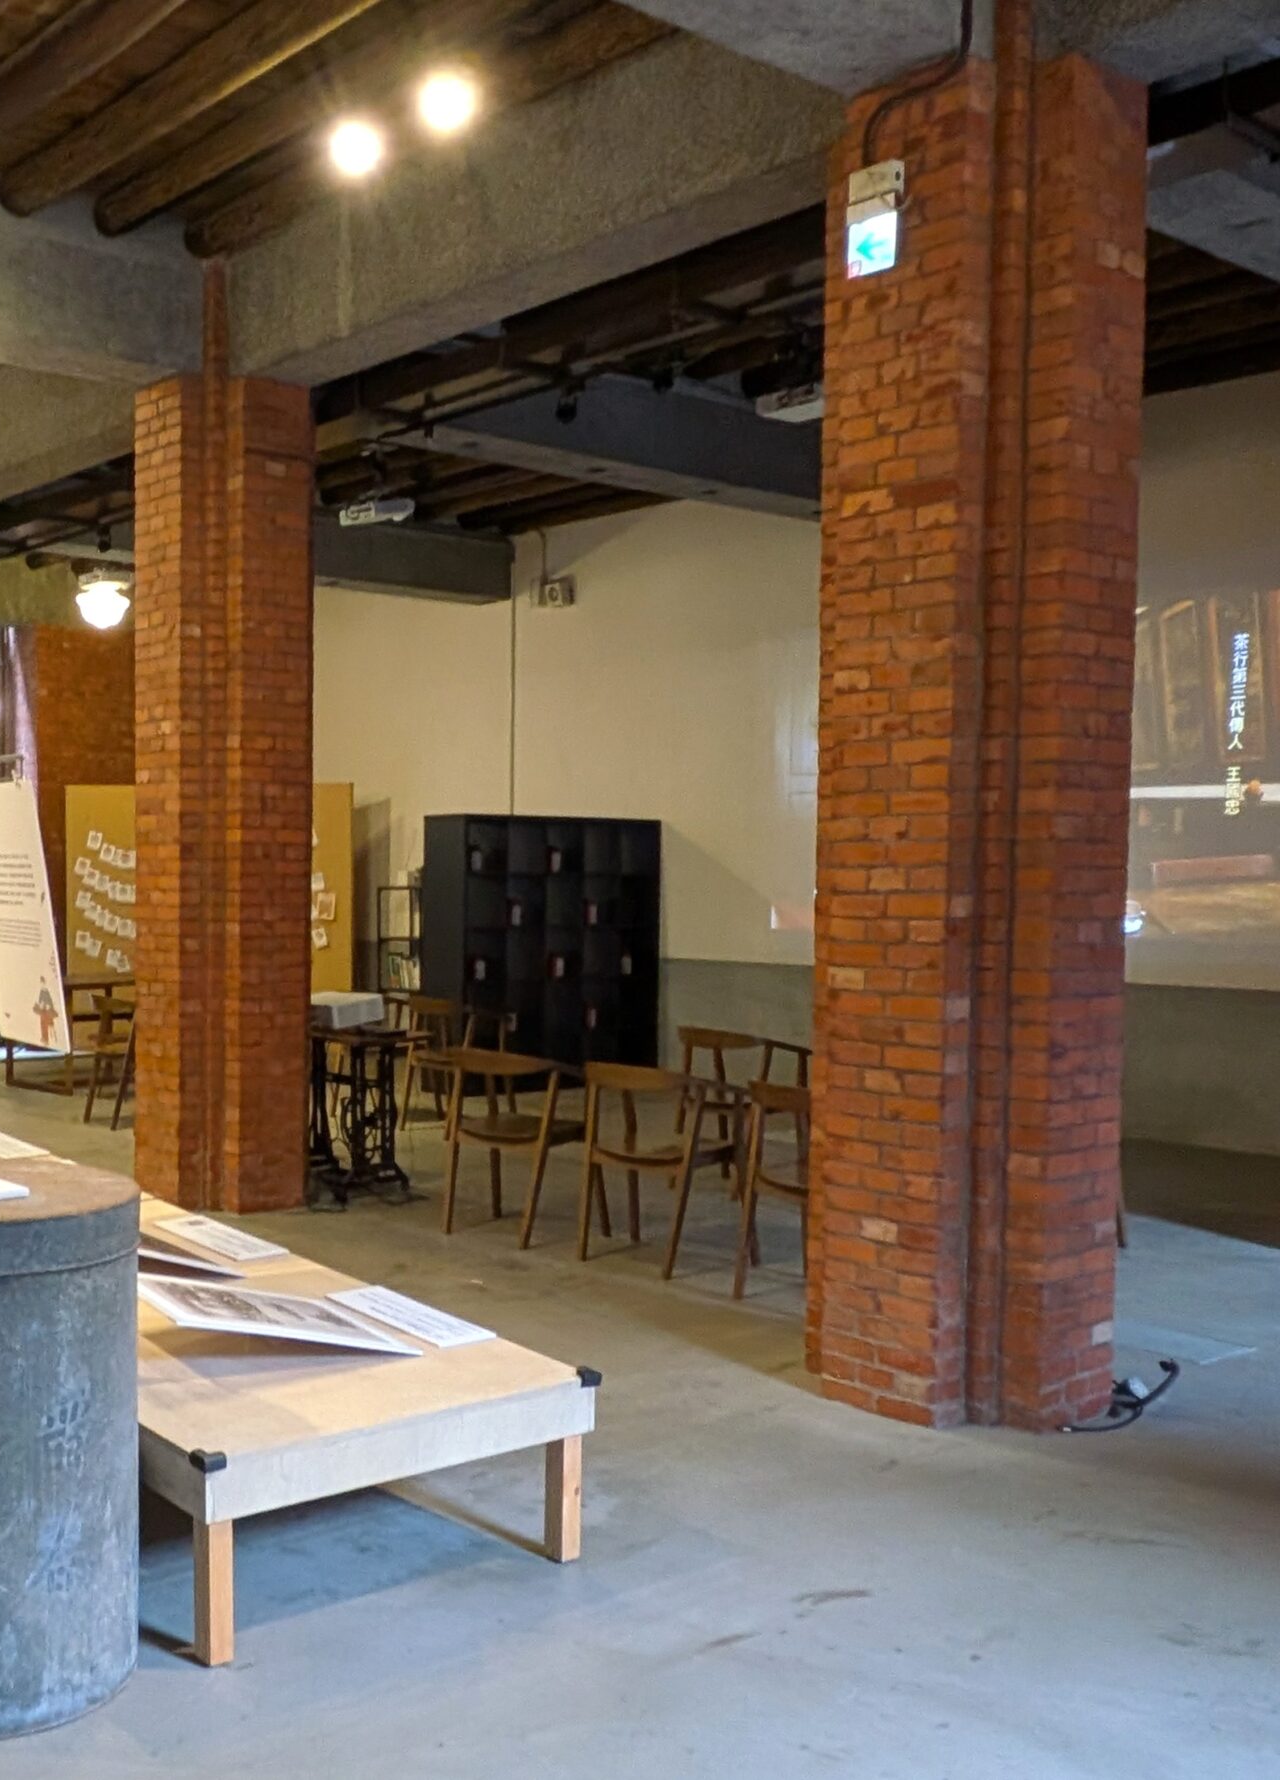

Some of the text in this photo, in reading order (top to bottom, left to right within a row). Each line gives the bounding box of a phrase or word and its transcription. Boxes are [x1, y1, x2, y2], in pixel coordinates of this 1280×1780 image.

[1227, 632, 1250, 751] 茶行第三代傳人
